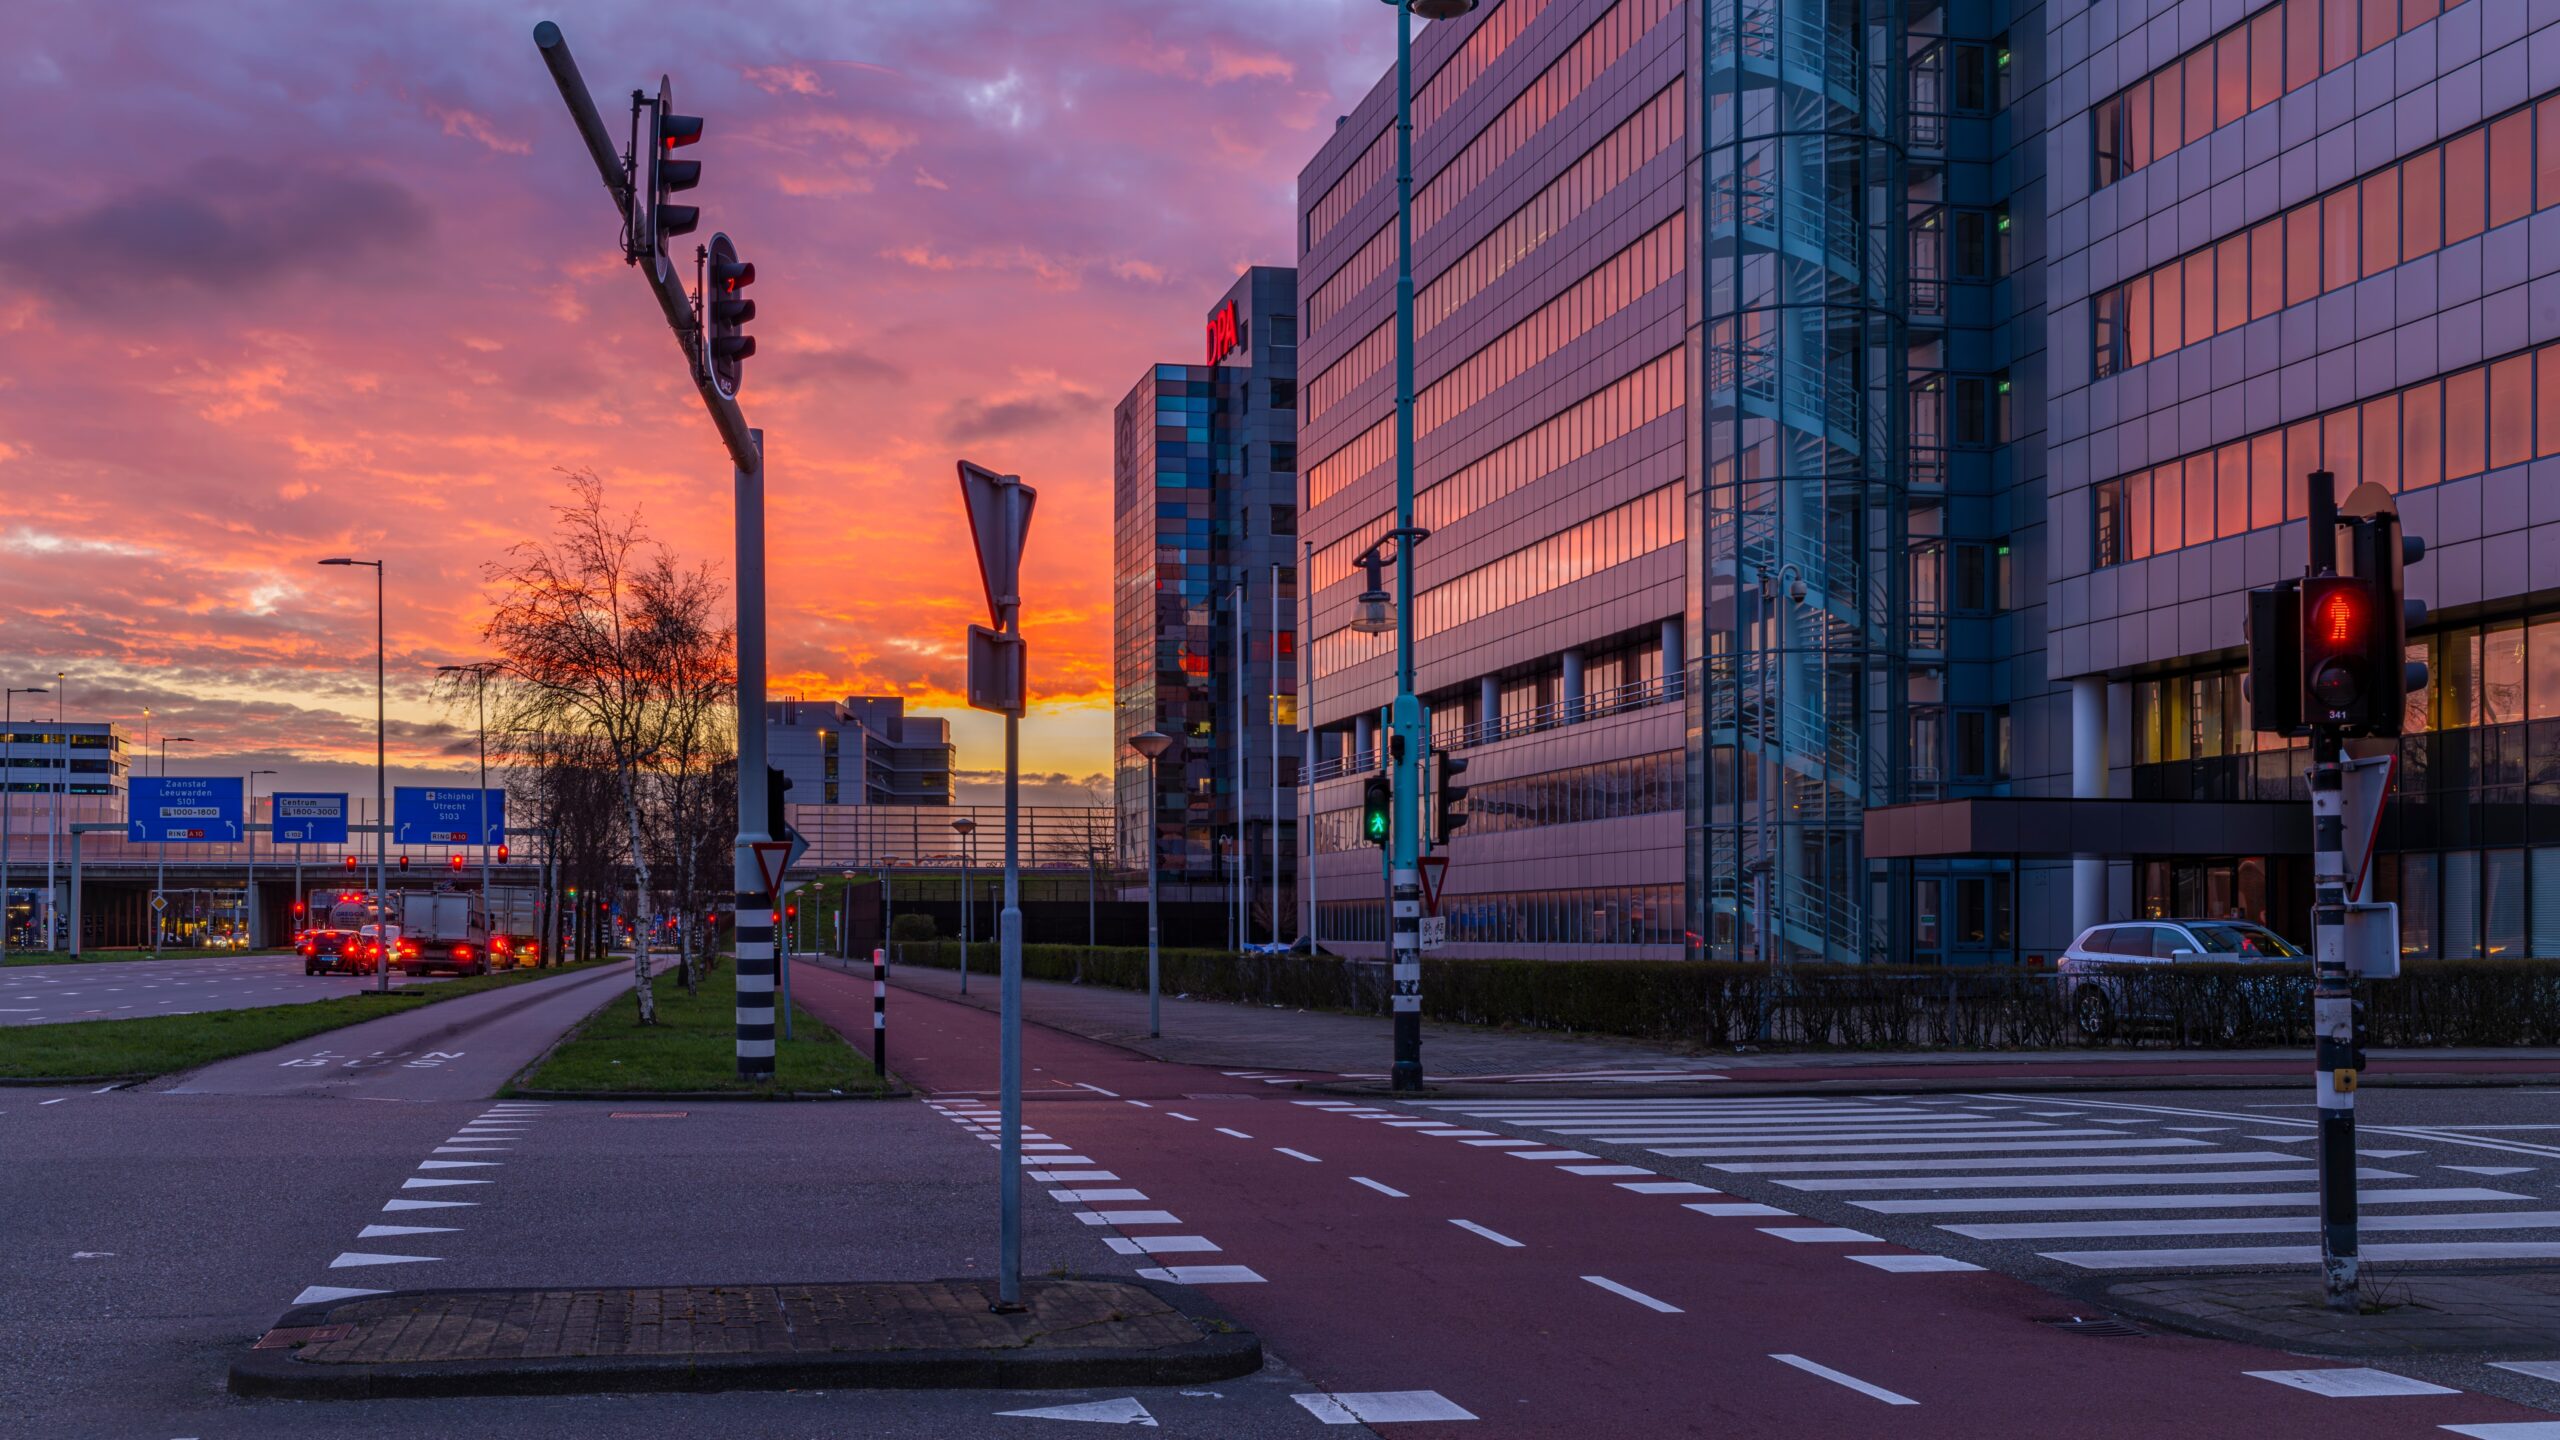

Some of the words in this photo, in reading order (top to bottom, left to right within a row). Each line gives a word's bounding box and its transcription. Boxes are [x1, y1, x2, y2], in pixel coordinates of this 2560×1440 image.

[1206, 298, 1238, 367] DPA
[2329, 710, 2346, 719] 341
[437, 792, 474, 801] Schiphol
[173, 808, 217, 816] 1000-1800
[278, 1058, 446, 1067] BUS
